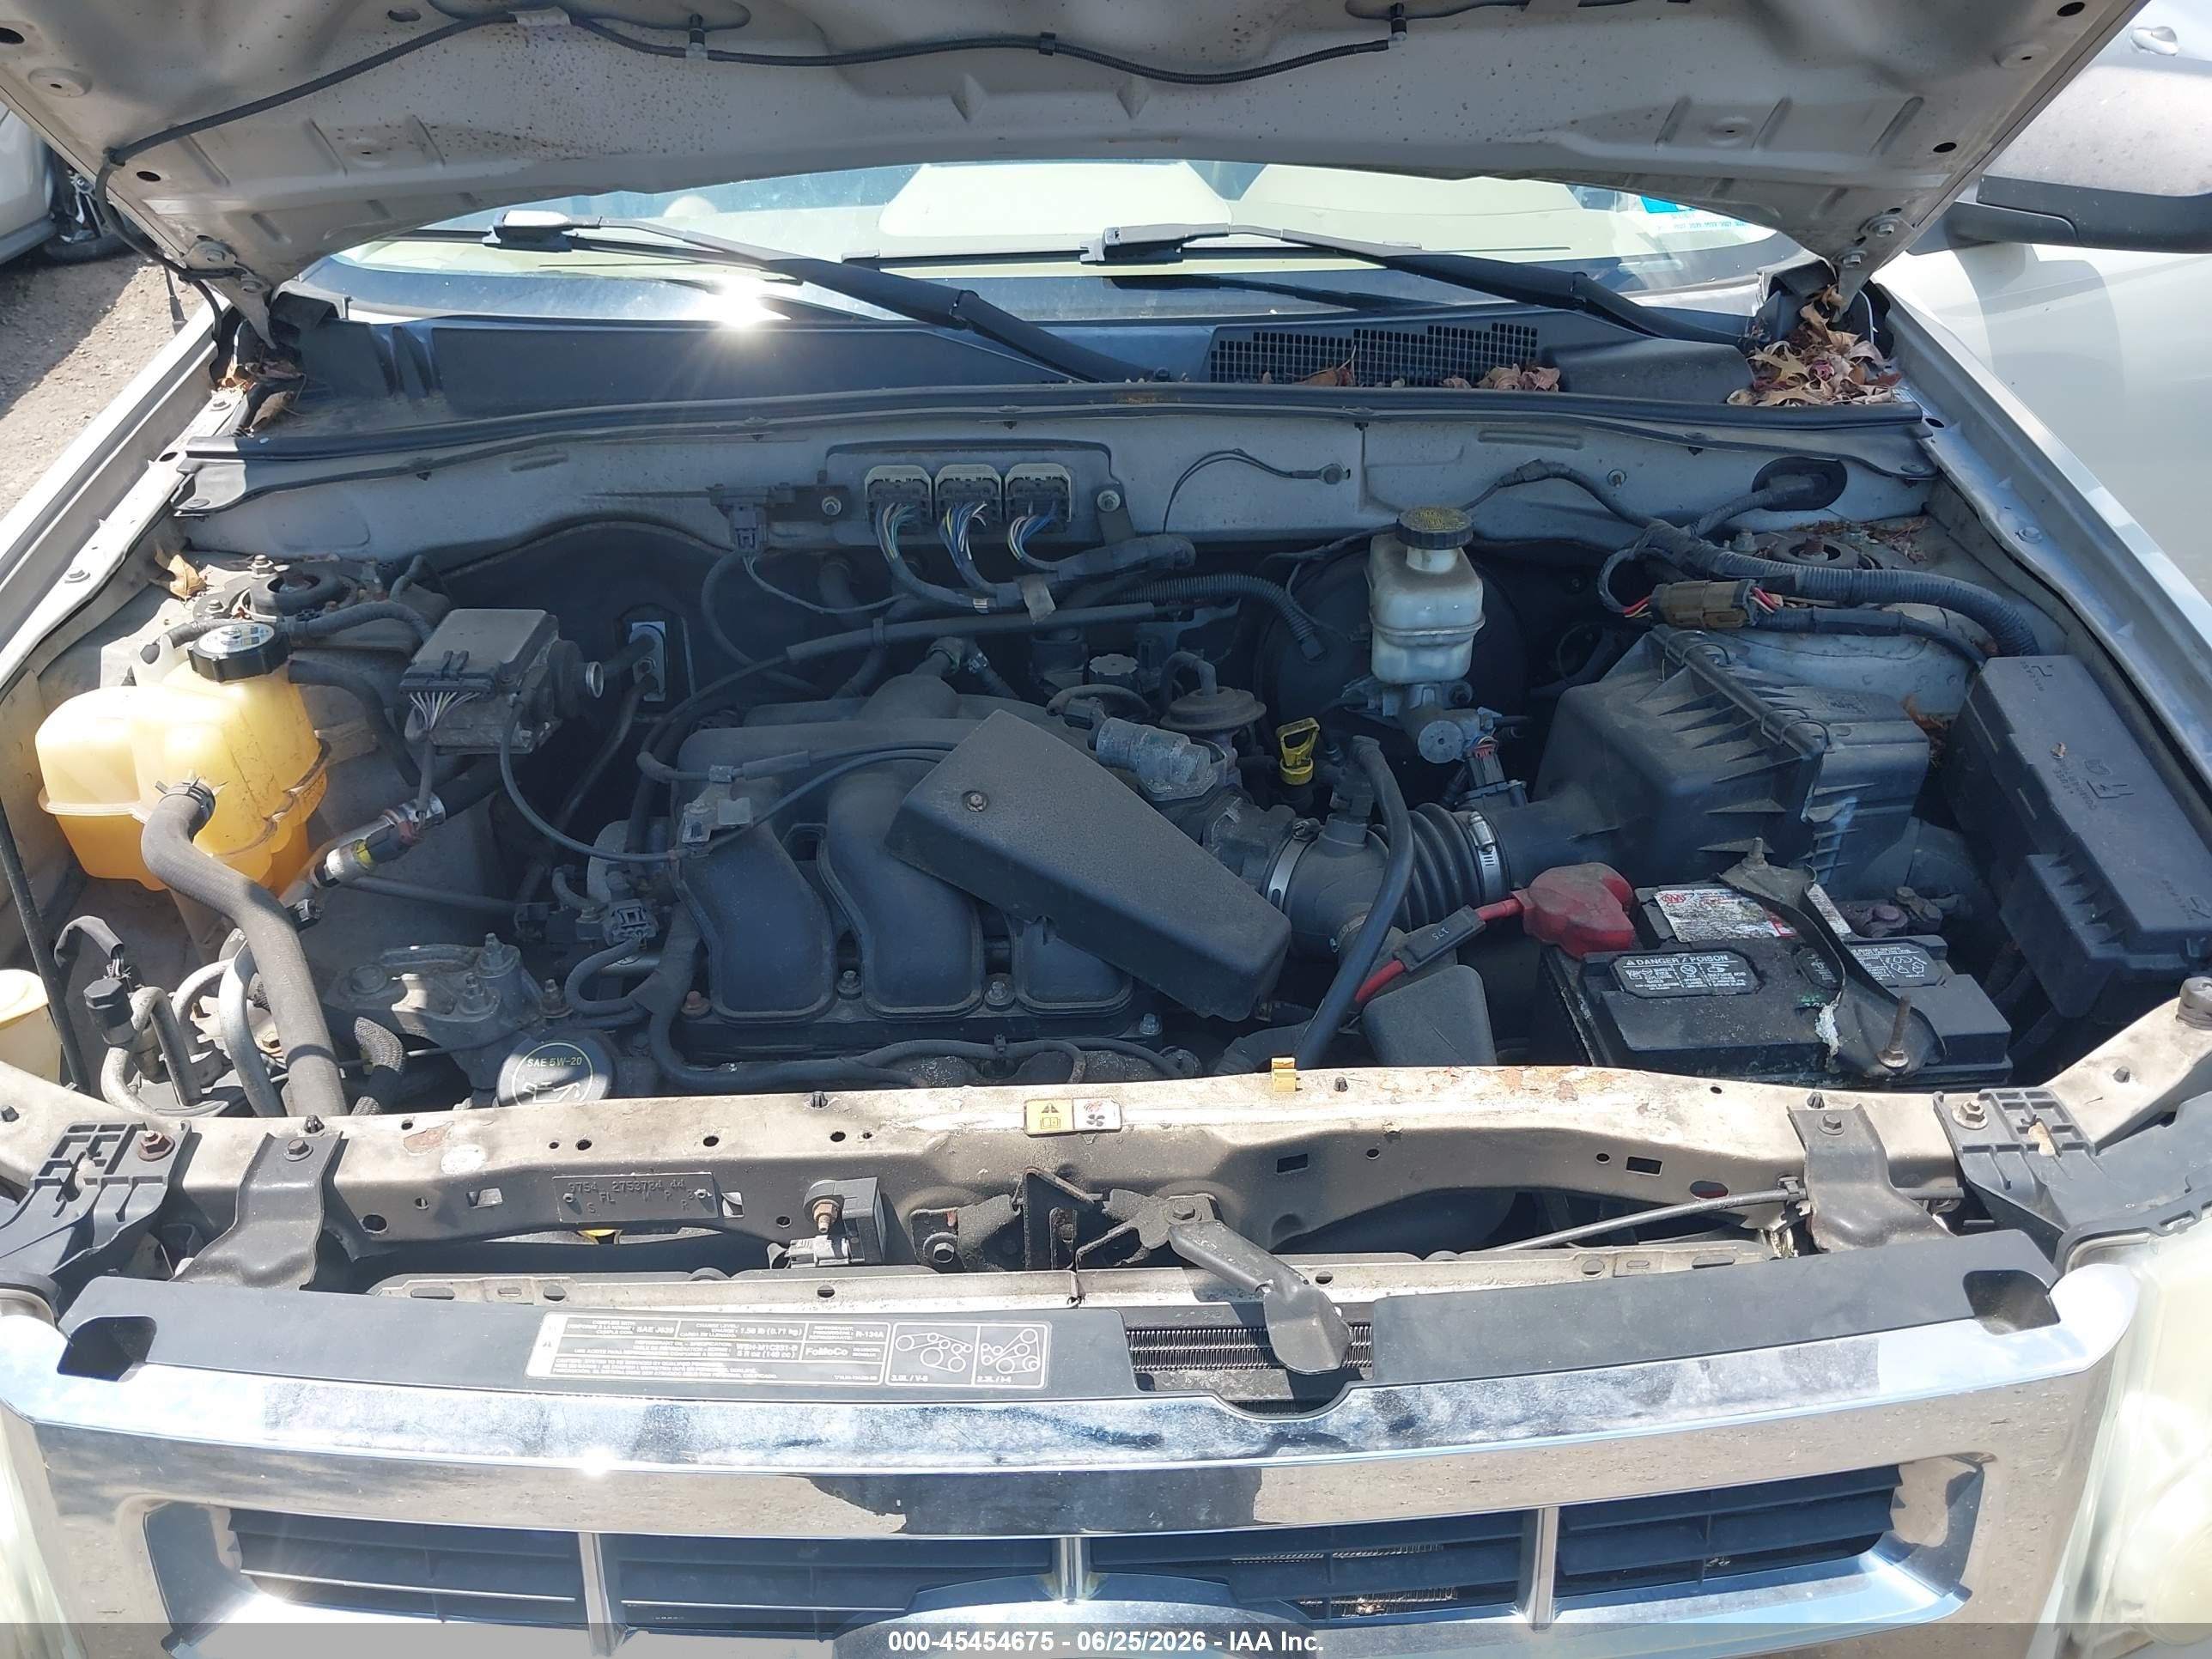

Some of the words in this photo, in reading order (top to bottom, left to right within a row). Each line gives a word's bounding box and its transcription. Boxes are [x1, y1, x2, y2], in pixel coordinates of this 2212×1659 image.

[1431, 927, 1449, 940] 175
[527, 1058, 547, 1067] SAE
[550, 1056, 582, 1066] 5W-20
[599, 1191, 616, 1204] FL
[586, 1202, 596, 1213] S
[787, 1328, 803, 1336] kg)
[855, 1330, 885, 1339] R-134A
[805, 1346, 848, 1356] FoMoCo
